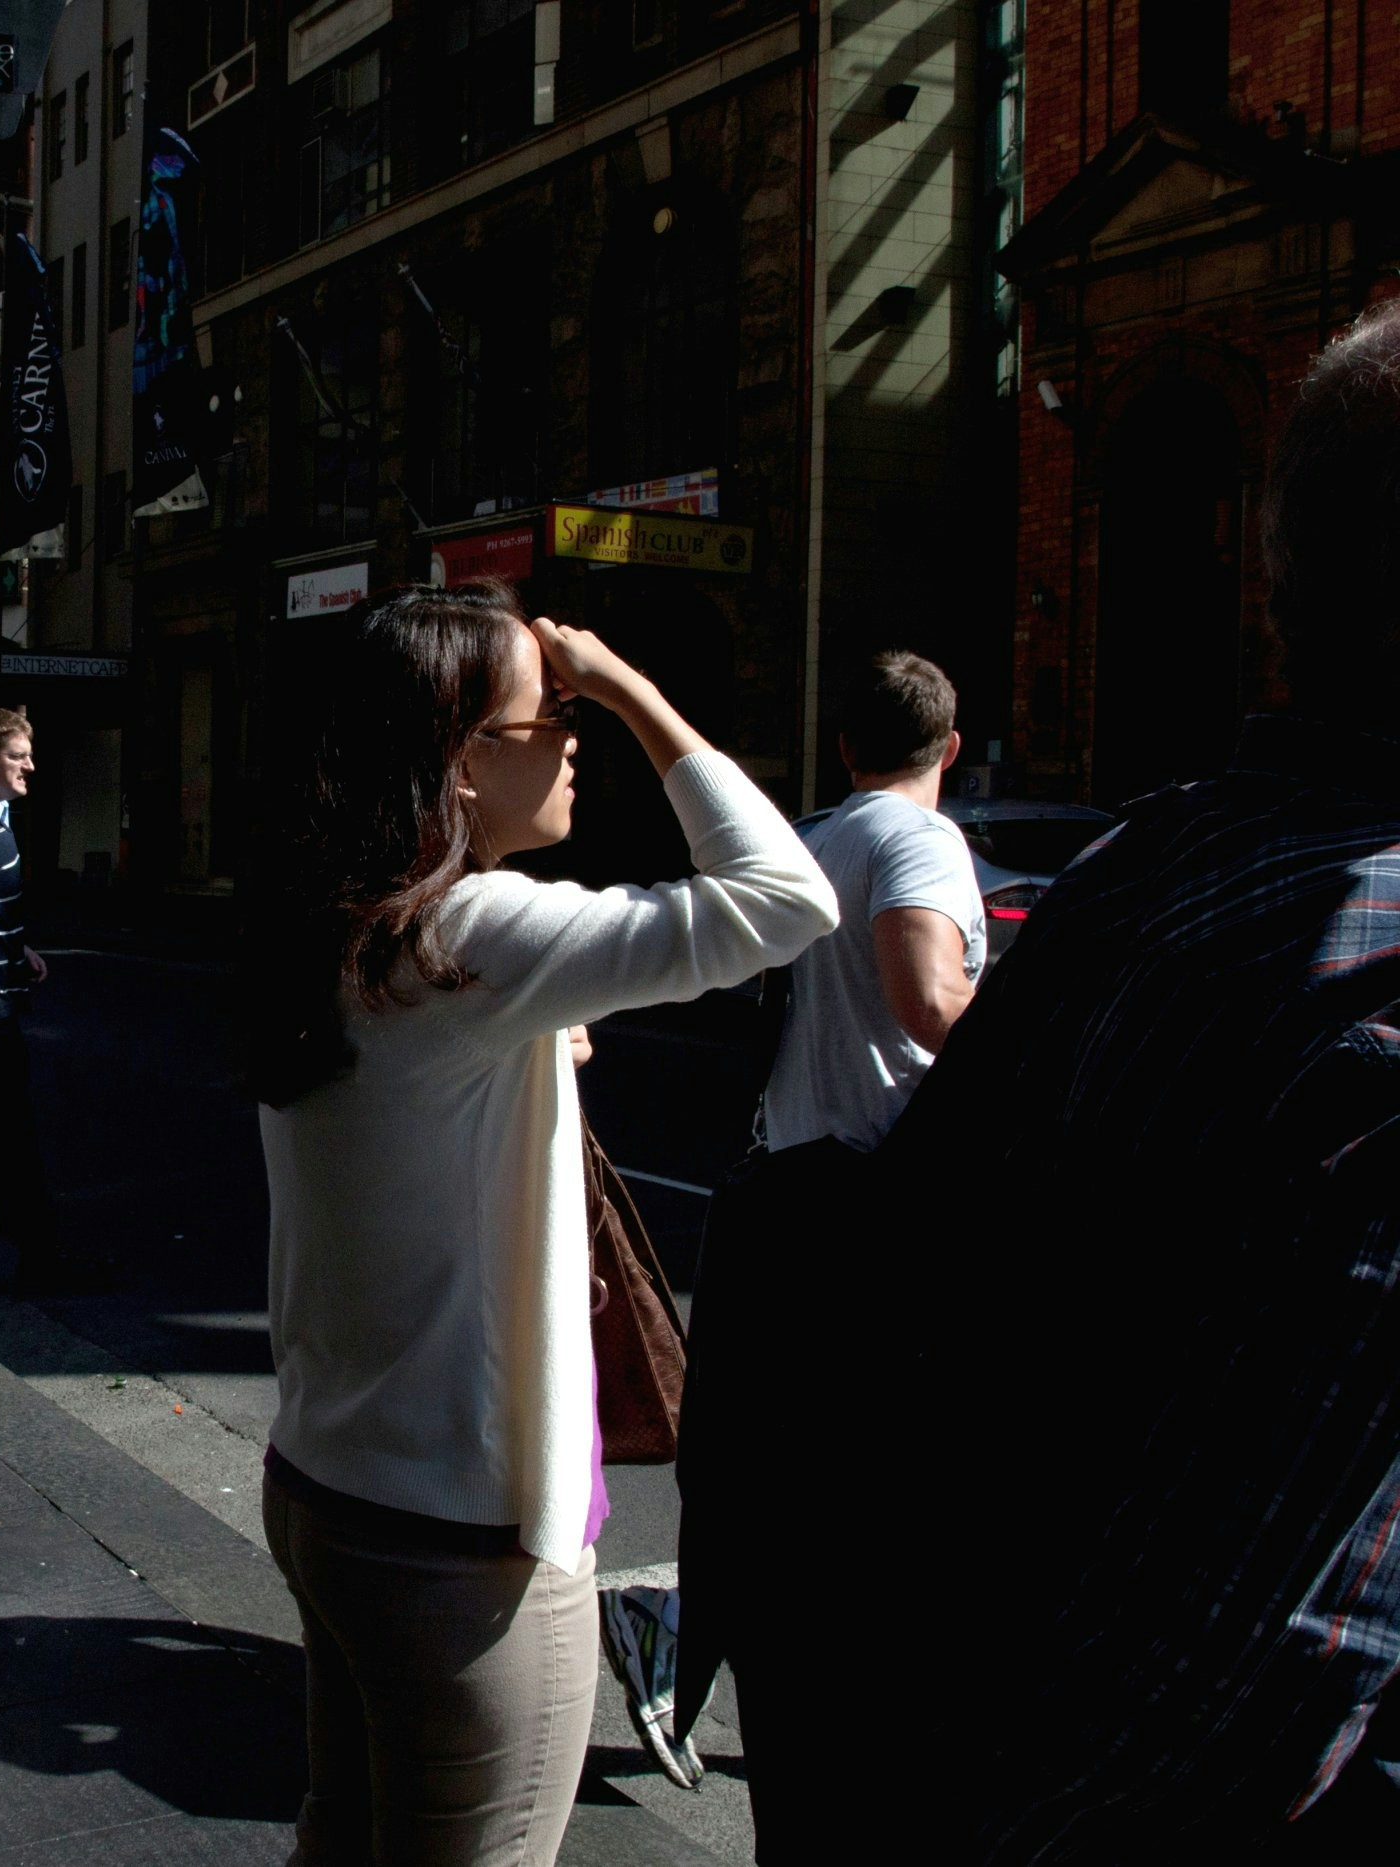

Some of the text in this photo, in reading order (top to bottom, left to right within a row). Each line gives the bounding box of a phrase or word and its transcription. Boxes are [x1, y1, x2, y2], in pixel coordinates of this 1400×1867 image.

[562, 517, 648, 552] Spanish
[651, 533, 705, 554] CLUB
[596, 549, 690, 565] VISITORS WELCOME
